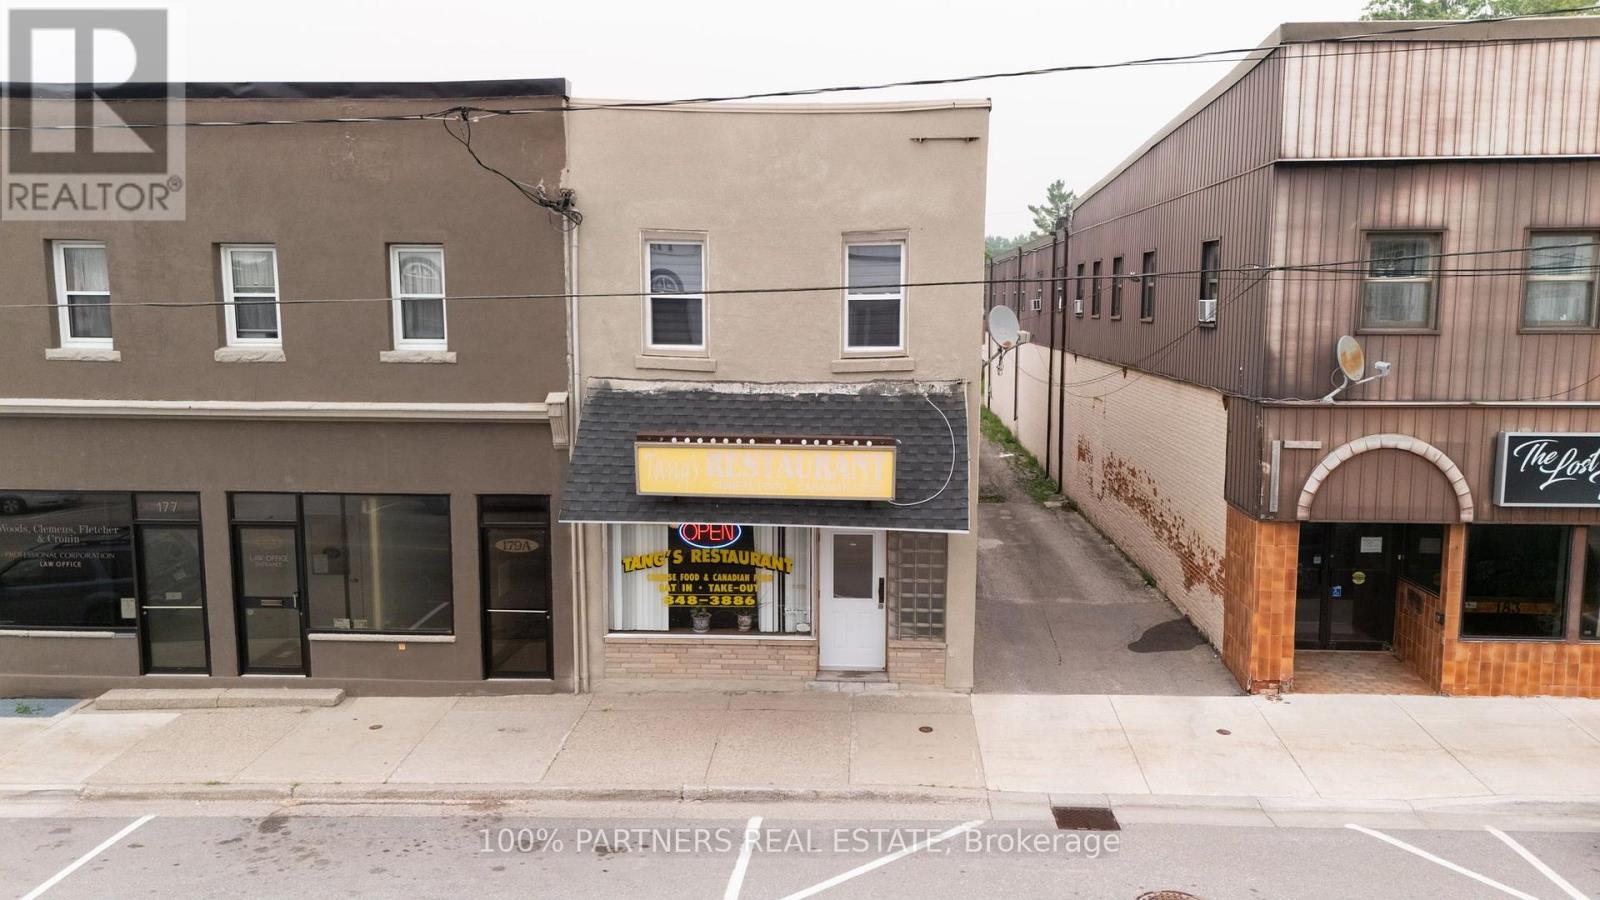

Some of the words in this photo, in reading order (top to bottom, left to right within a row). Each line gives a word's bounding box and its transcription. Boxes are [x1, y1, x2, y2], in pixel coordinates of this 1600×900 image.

[706, 449, 888, 481] RESTAURANT
[1513, 439, 1559, 472] The
[1540, 447, 1600, 491] Lost
[157, 501, 178, 512] 177
[33, 524, 77, 535] Clemens,
[79, 525, 119, 534] Fletcher
[682, 524, 735, 541] OPEN
[37, 535, 45, 543] &
[47, 534, 80, 543] Cronin
[503, 540, 530, 551] 179A
[621, 551, 684, 573] TANG'S
[691, 549, 793, 574] RESTAURANT
[680, 572, 700, 581] FOOD
[703, 573, 709, 581] &
[713, 573, 750, 581] CANADIAN
[682, 583, 693, 592] IN
[708, 583, 759, 592] TAKE-OUT
[664, 595, 756, 606] 848-3886
